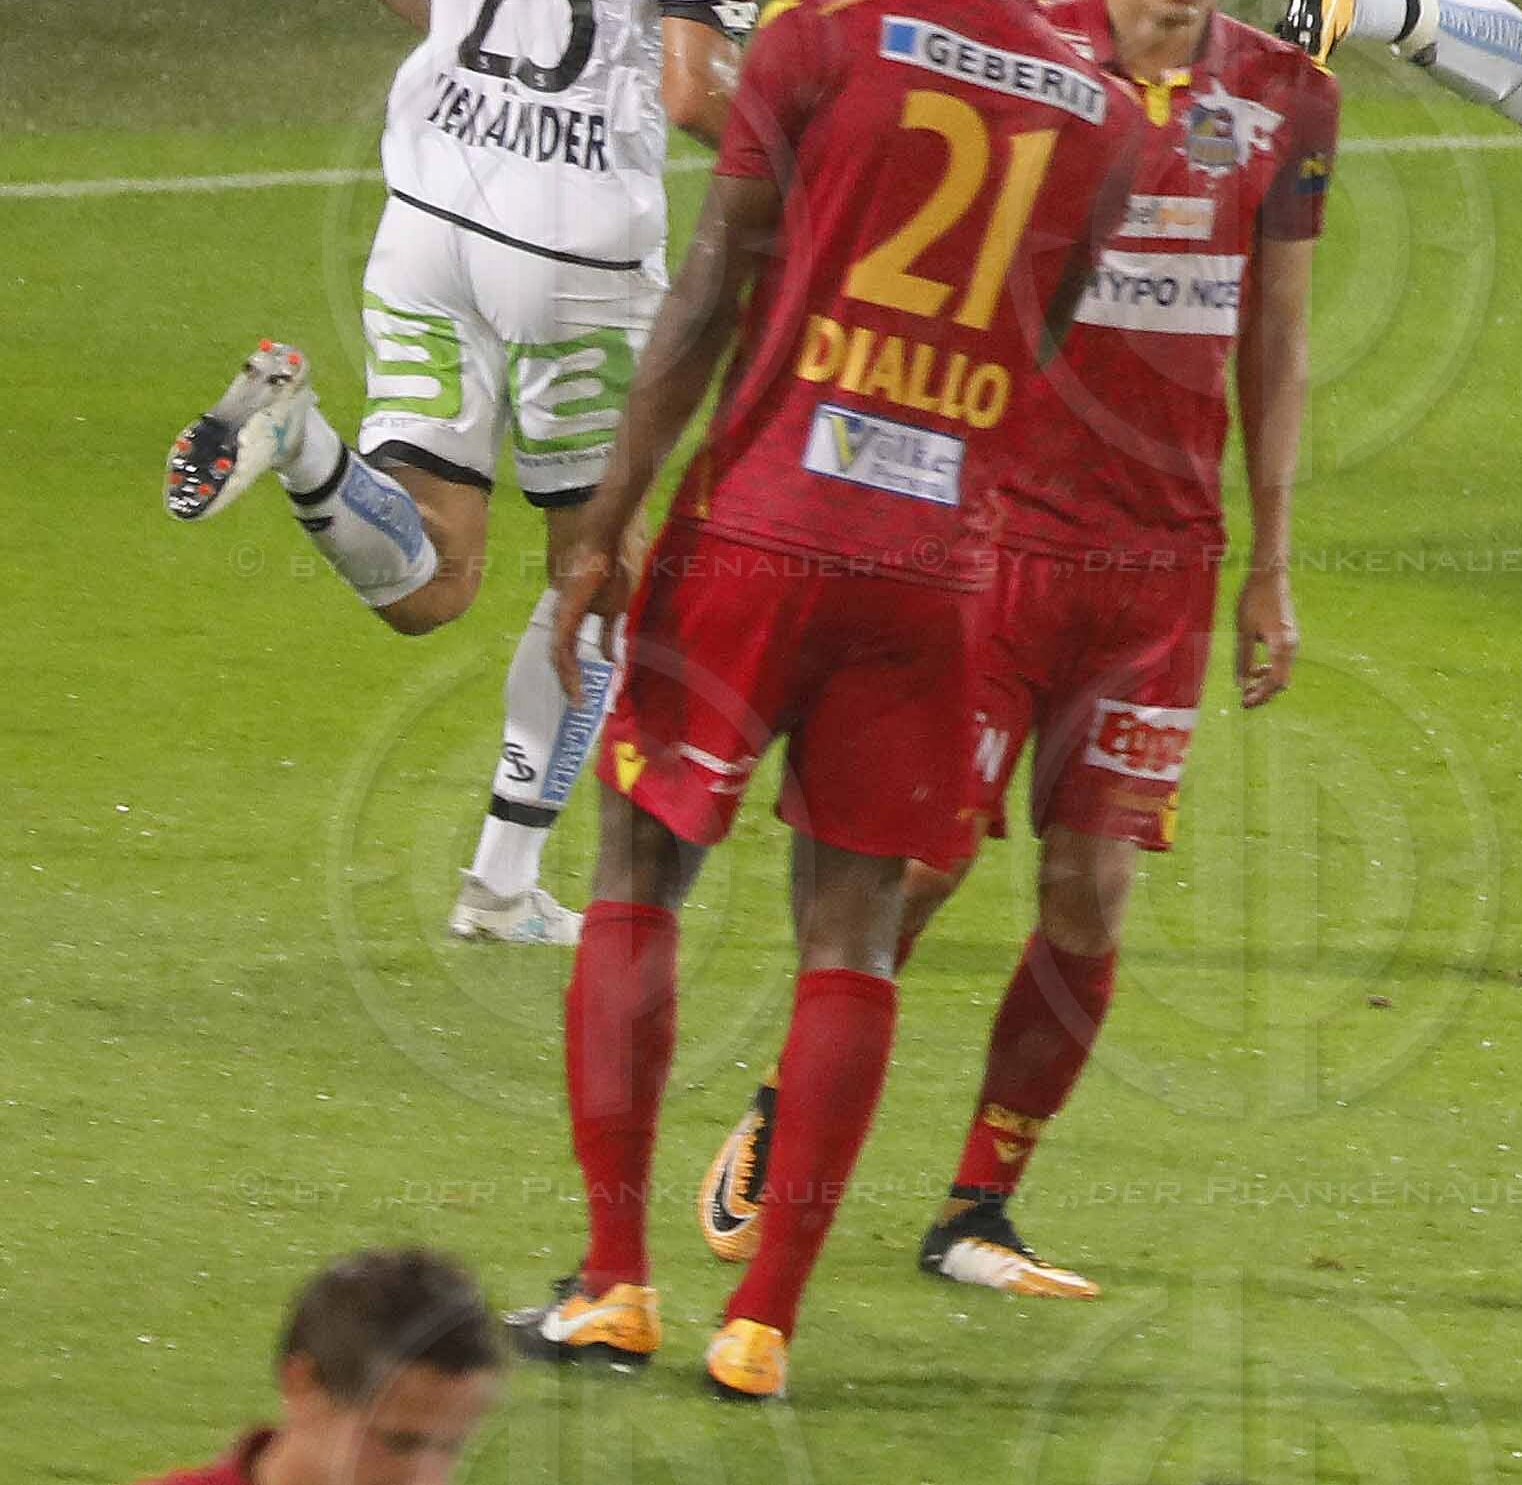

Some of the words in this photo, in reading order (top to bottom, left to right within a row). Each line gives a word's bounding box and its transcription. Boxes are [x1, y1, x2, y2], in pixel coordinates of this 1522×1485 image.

[924, 31, 1102, 112] GEBERIT
[845, 87, 1058, 332] 21
[795, 315, 1011, 429] DIALLO
